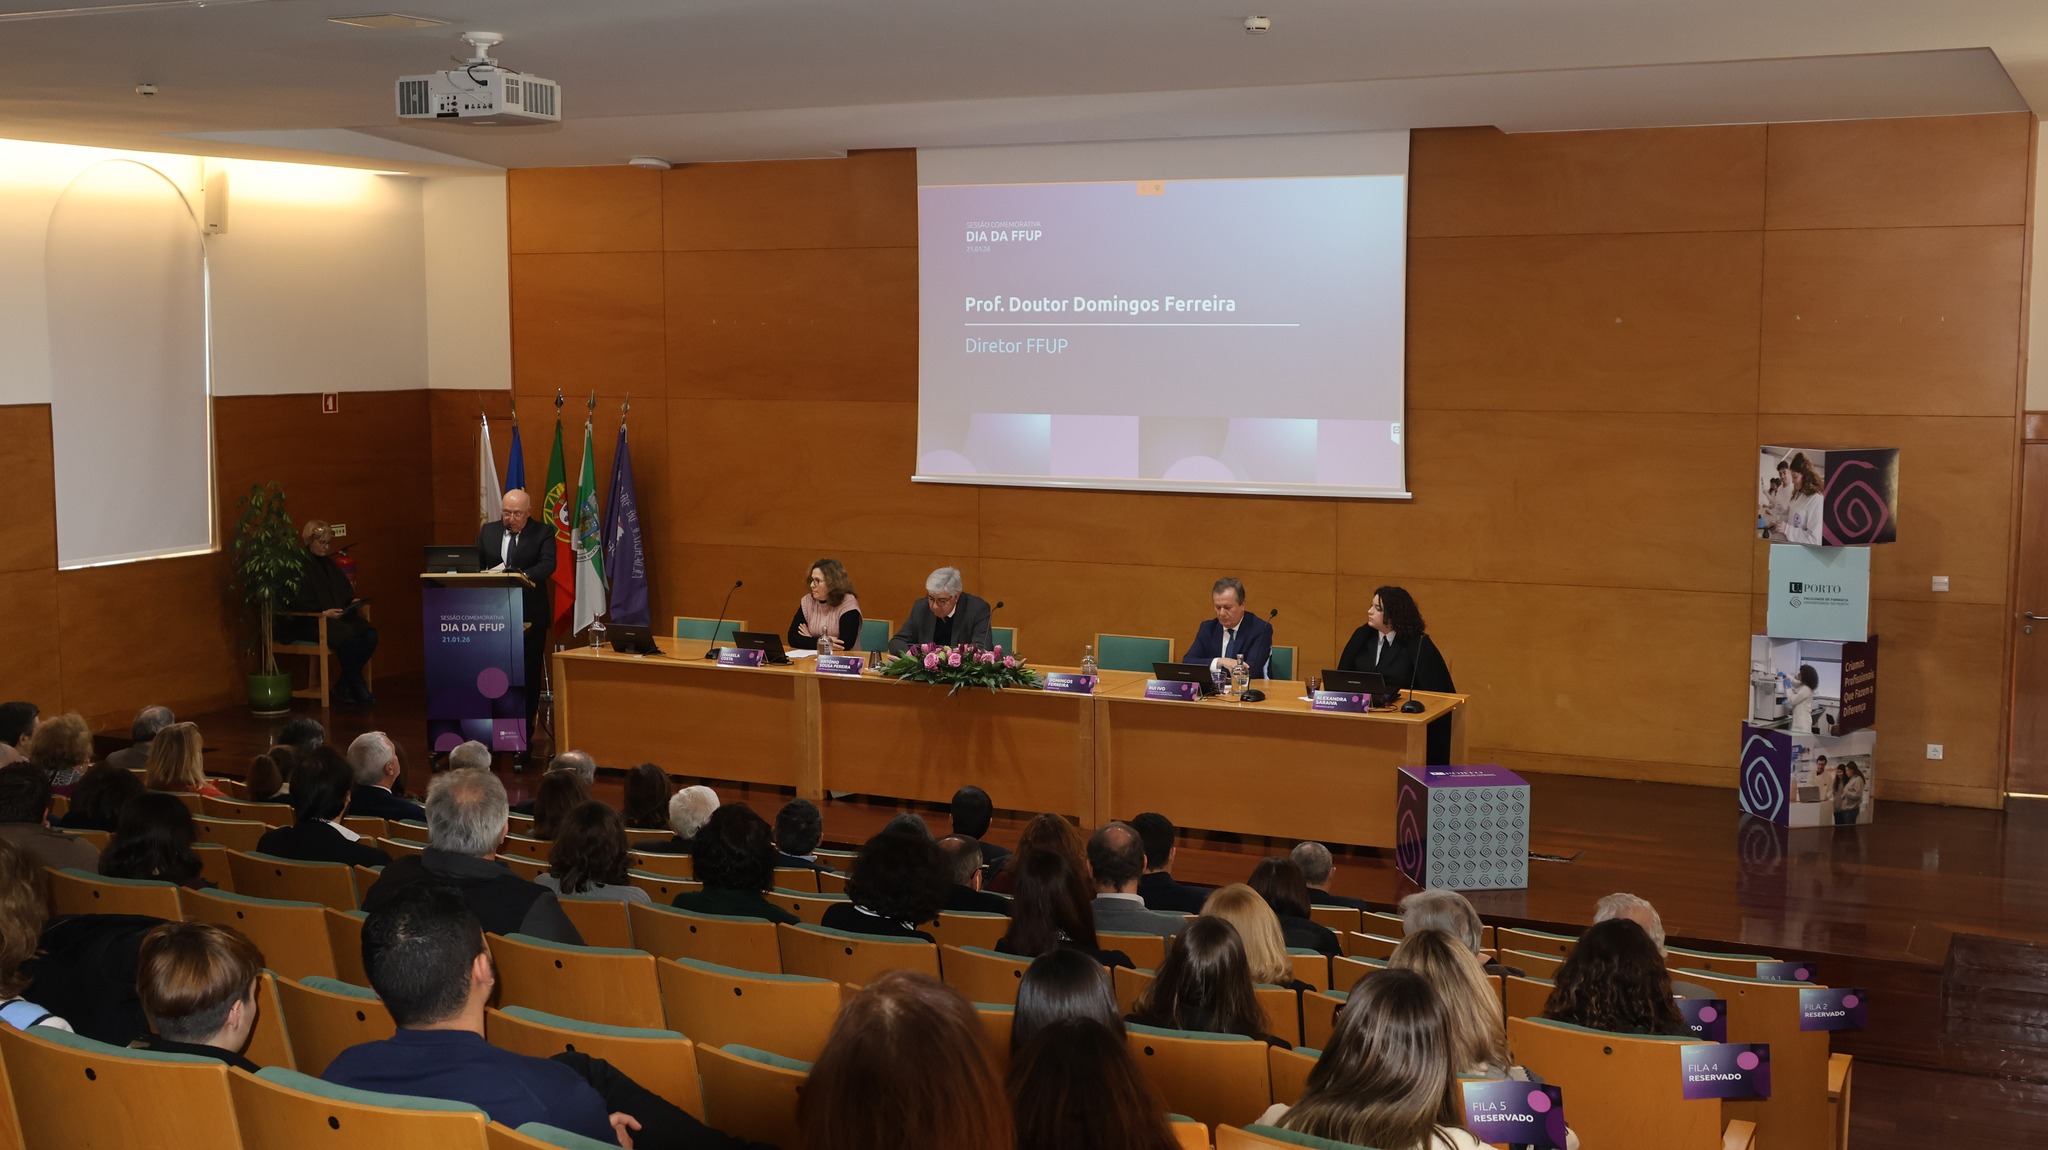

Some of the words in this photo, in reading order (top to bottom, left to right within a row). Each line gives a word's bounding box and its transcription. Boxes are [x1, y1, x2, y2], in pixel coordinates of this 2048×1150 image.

[966, 230, 988, 242] DIA
[991, 230, 1008, 242] DA
[1011, 230, 1042, 241] FFUP
[965, 295, 1004, 312] Prof.
[1009, 296, 1069, 312] Doutor
[1073, 295, 1160, 315] Domingos
[1165, 295, 1236, 312] Ferreira
[965, 338, 1023, 353] Diretor
[1027, 338, 1068, 353] FFUP
[1804, 584, 1841, 593] PORTO
[441, 623, 459, 632] DIA
[462, 623, 477, 632] DA
[479, 623, 505, 632] FFUP
[1845, 660, 1865, 672] Criamos
[1845, 669, 1874, 687] Profissionais
[1844, 692, 1854, 703] Que
[1855, 687, 1870, 698] Fazem
[1843, 703, 1866, 717] Diferença
[1688, 1064, 1710, 1072] FILA
[1689, 1073, 1742, 1082] RESERVADO
[1472, 1102, 1498, 1111] FILA
[1500, 1101, 1507, 1111] 5
[1474, 1114, 1534, 1123] RESERVADO
